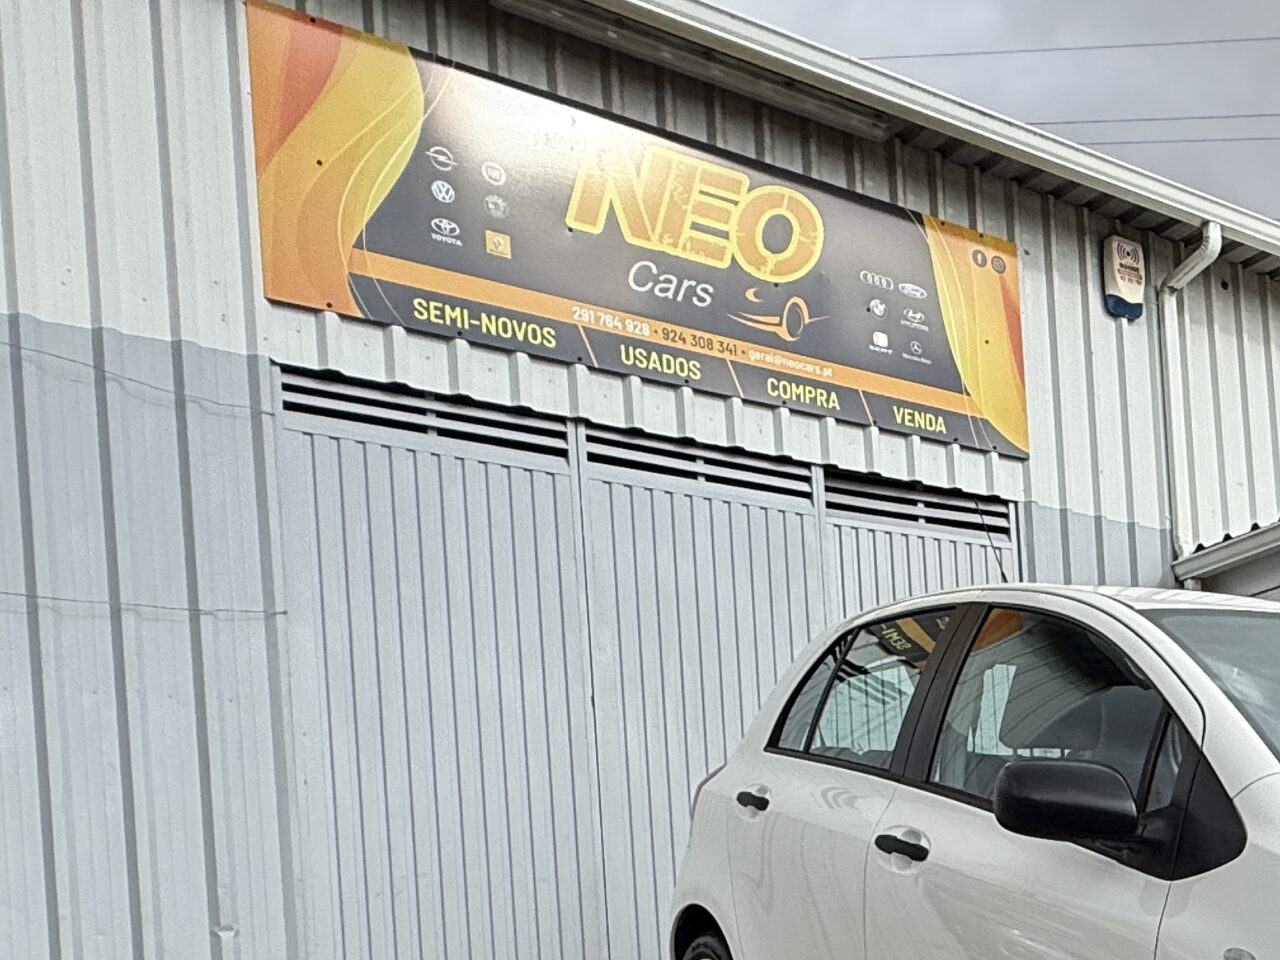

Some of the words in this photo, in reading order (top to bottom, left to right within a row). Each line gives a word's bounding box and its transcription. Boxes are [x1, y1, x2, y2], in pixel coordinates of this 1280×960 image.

[565, 145, 824, 283] NEO
[430, 232, 463, 247] TOYOTA
[627, 260, 714, 308] Cars
[412, 298, 557, 348] SEMI-NOVOS
[571, 306, 595, 323] 291
[599, 312, 622, 331] 764
[625, 320, 651, 337] 928
[662, 327, 687, 345] 924
[690, 334, 714, 350] 308
[717, 340, 738, 356] 341
[748, 349, 833, 378] geral@neocars.pt
[619, 344, 701, 380] USADOS
[766, 377, 841, 411] COMPRA
[892, 405, 948, 434] VENDA
